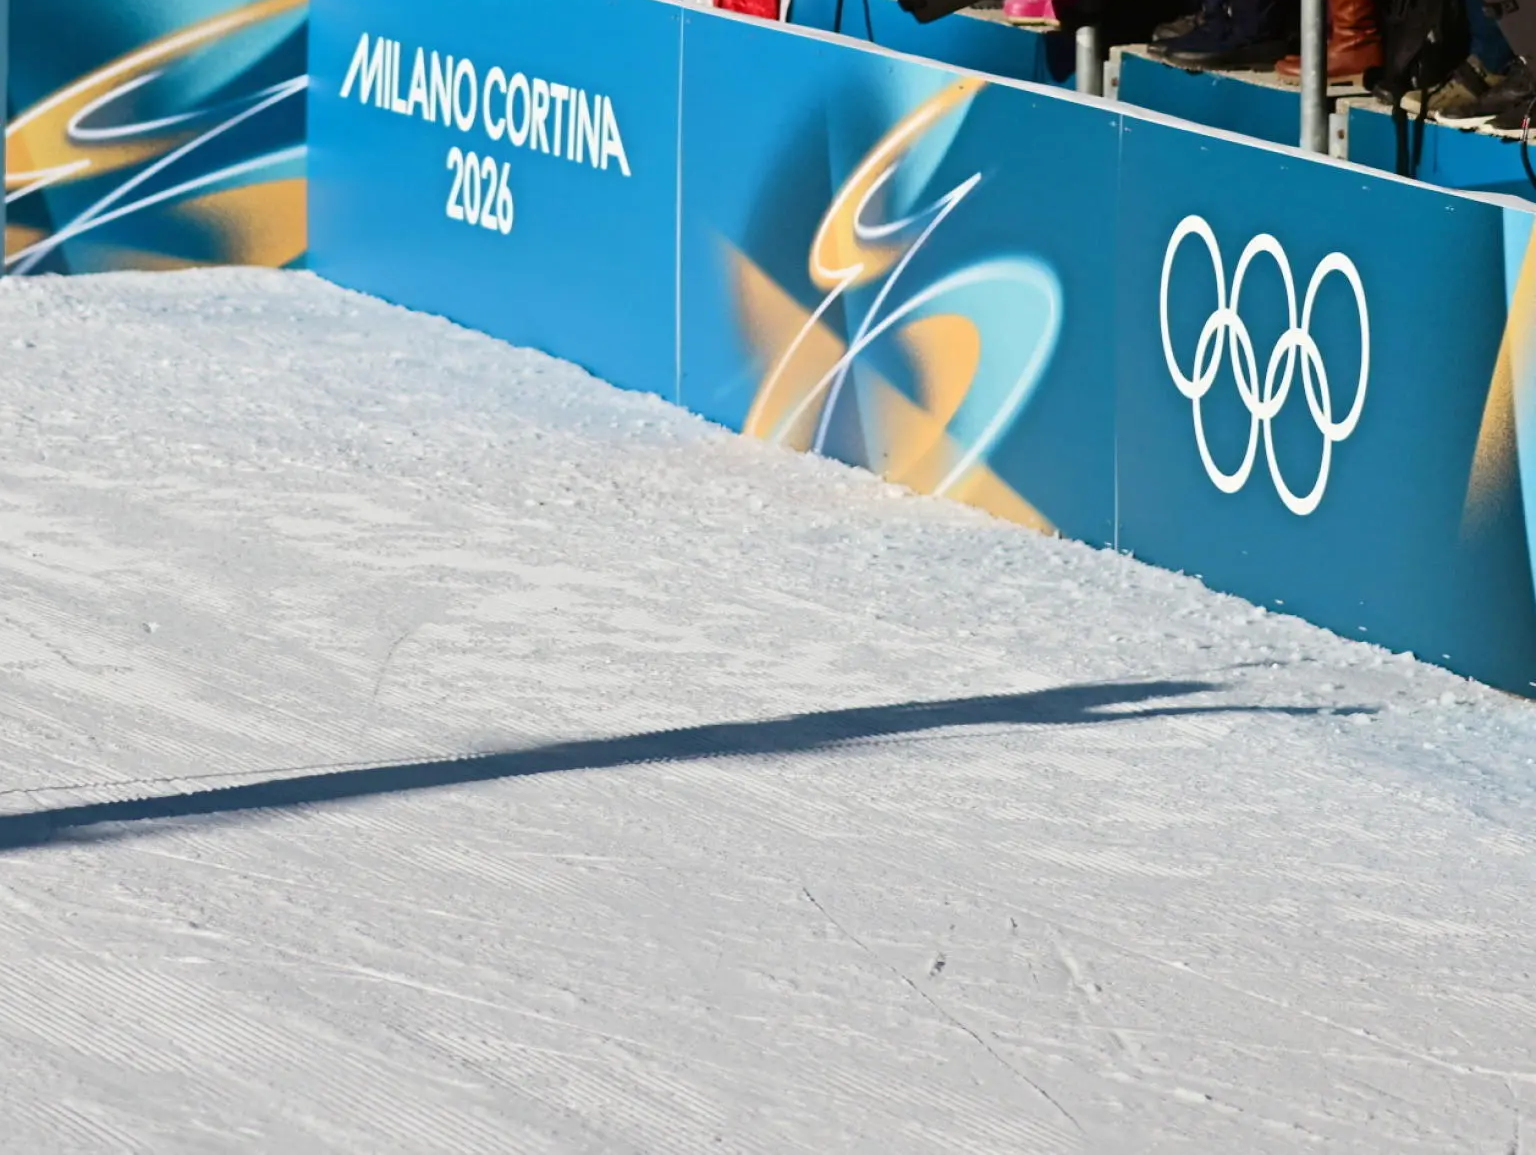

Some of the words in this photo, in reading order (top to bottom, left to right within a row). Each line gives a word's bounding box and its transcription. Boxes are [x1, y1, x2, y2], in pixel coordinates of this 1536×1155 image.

[339, 32, 478, 132] MILANO
[482, 65, 632, 177] CORTINA
[445, 146, 515, 235] 2026
